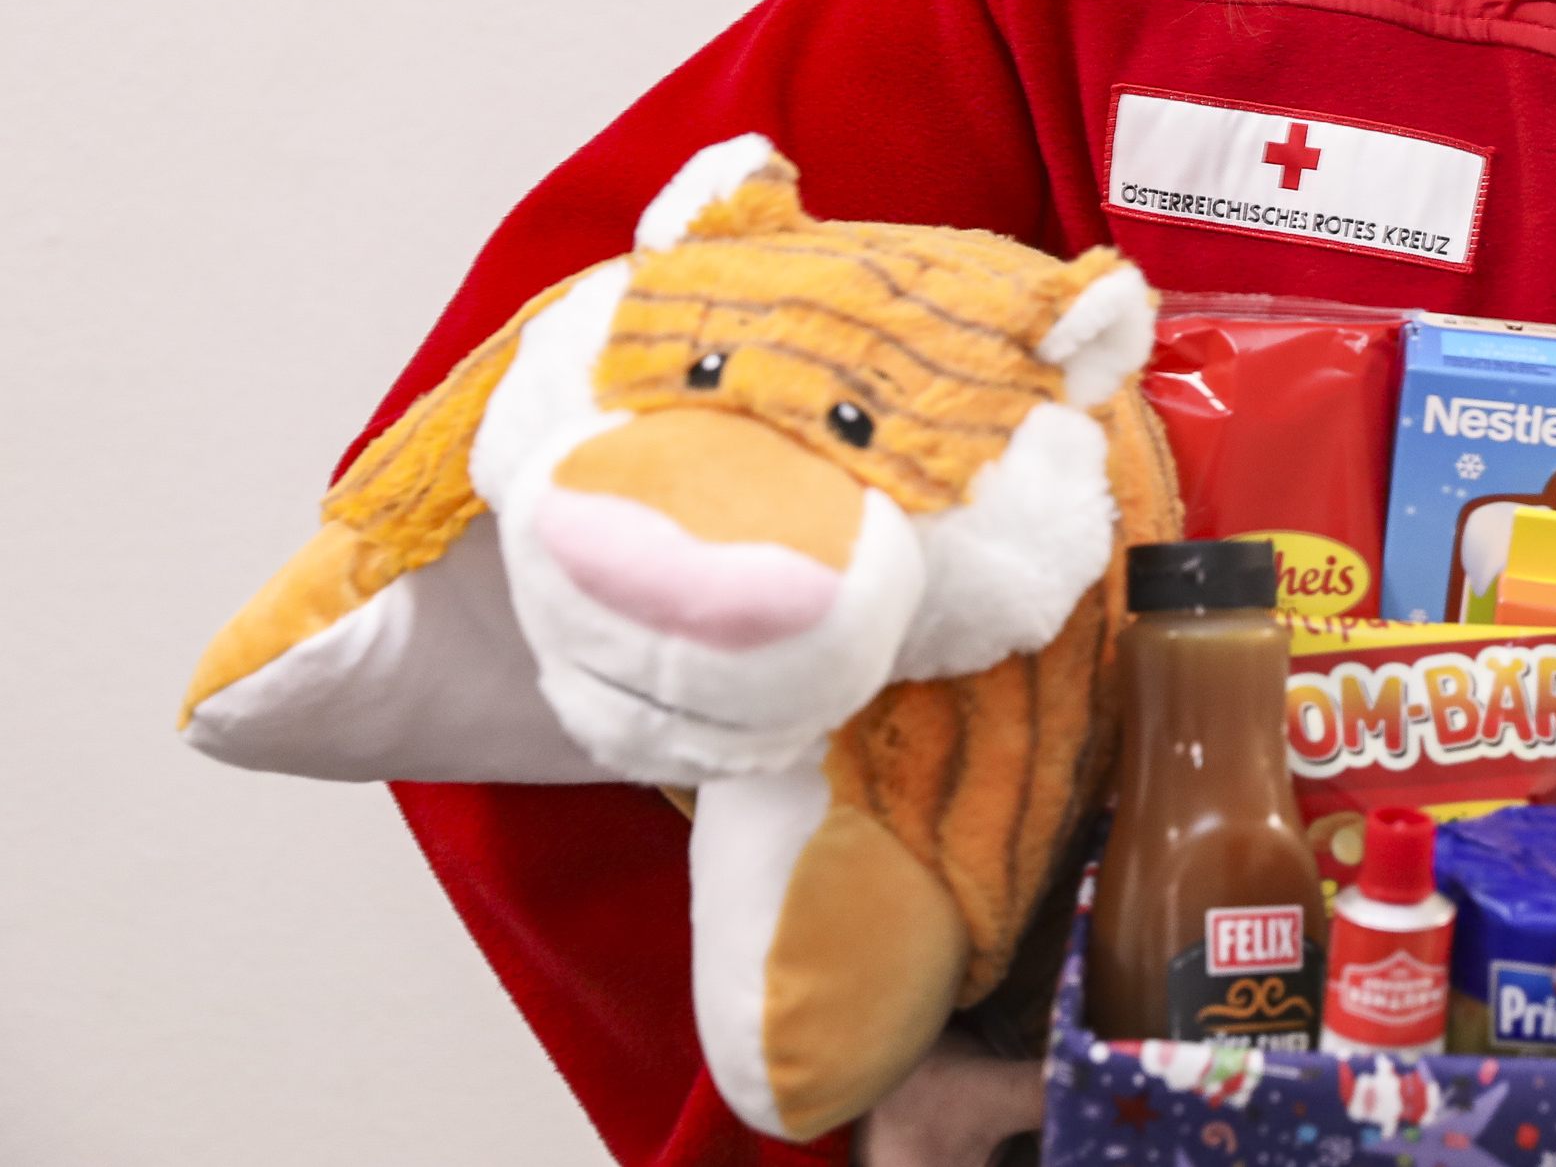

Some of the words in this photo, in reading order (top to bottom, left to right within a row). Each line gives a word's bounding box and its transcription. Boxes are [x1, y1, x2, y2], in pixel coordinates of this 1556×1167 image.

[1121, 181, 1308, 230] ÖSTERREICHISCHES
[1312, 212, 1376, 241] ROTES
[1381, 228, 1451, 256] KREUZ
[1275, 550, 1355, 596] heis
[1218, 916, 1294, 963] FELIX
